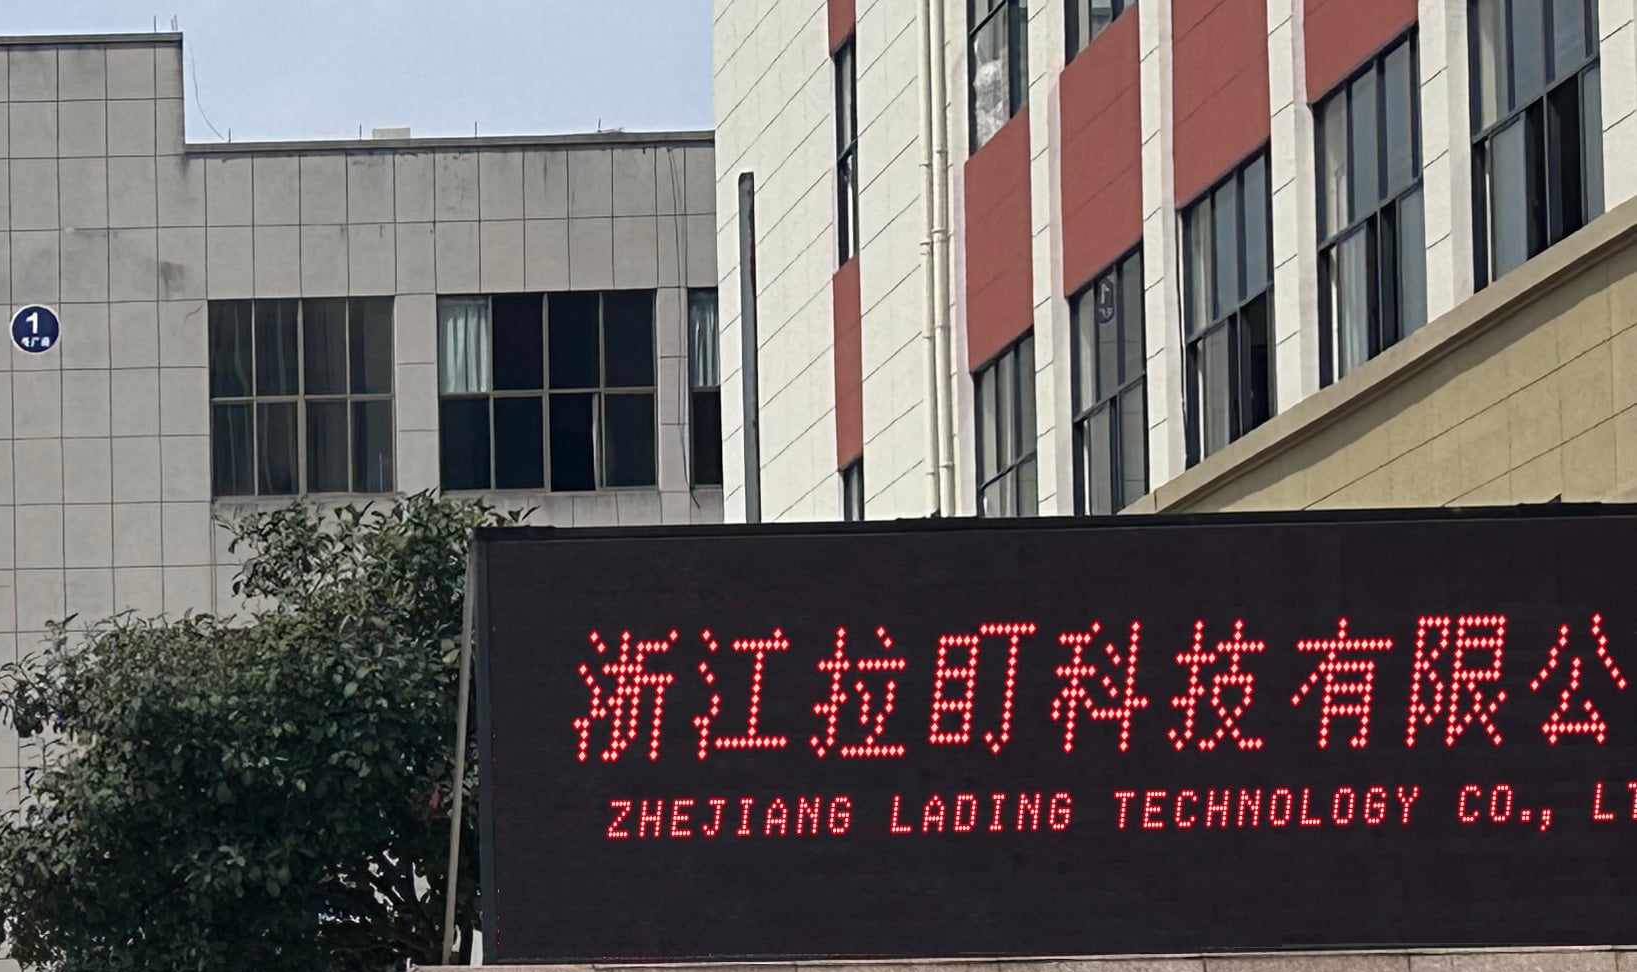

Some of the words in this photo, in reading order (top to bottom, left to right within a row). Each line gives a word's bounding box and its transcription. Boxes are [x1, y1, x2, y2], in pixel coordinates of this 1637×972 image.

[25, 312, 38, 334] 1
[573, 612, 1627, 762] 浙江拉盯科技有限公
[607, 796, 853, 839] ZHEJIANG
[890, 791, 1073, 834] LADING
[1114, 786, 1420, 830] TECHNOLOGY
[1458, 784, 1552, 832] CO.,
